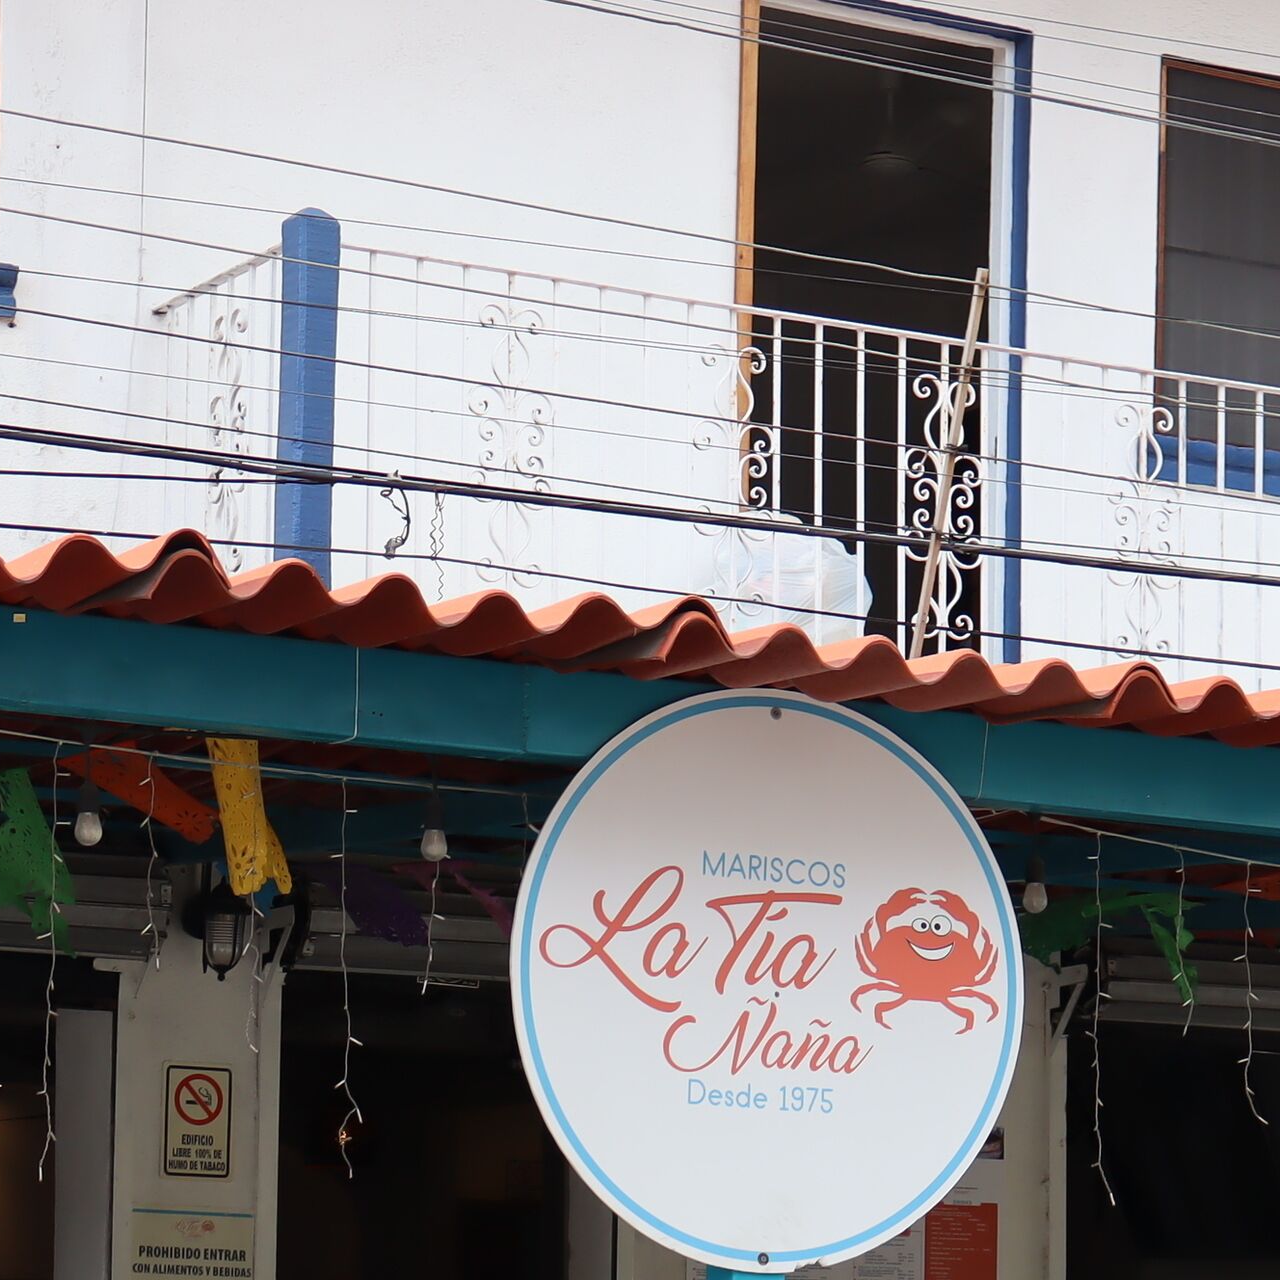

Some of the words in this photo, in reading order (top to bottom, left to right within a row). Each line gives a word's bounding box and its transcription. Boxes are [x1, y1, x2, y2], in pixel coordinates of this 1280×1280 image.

[702, 850, 847, 889] MARISCOS
[539, 865, 709, 1012] La
[706, 891, 843, 994] Tía
[663, 997, 875, 1075] Ñaña
[687, 1078, 768, 1109] Desde
[778, 1084, 834, 1113] 1975
[181, 1133, 214, 1146] EDIFICIO
[172, 1147, 191, 1158] LIBRE
[195, 1148, 212, 1159] 100%
[213, 1149, 222, 1159] DE
[168, 1159, 188, 1170] HUMO
[189, 1160, 198, 1170] DE
[200, 1161, 225, 1171] TABACO
[138, 1245, 201, 1260] PROHIBIDO
[204, 1248, 246, 1261] ENTRAR
[132, 1263, 150, 1273] CON
[152, 1263, 203, 1276] ALIMENTOS
[205, 1266, 211, 1276] Y
[213, 1266, 252, 1278] BEBIDAS
